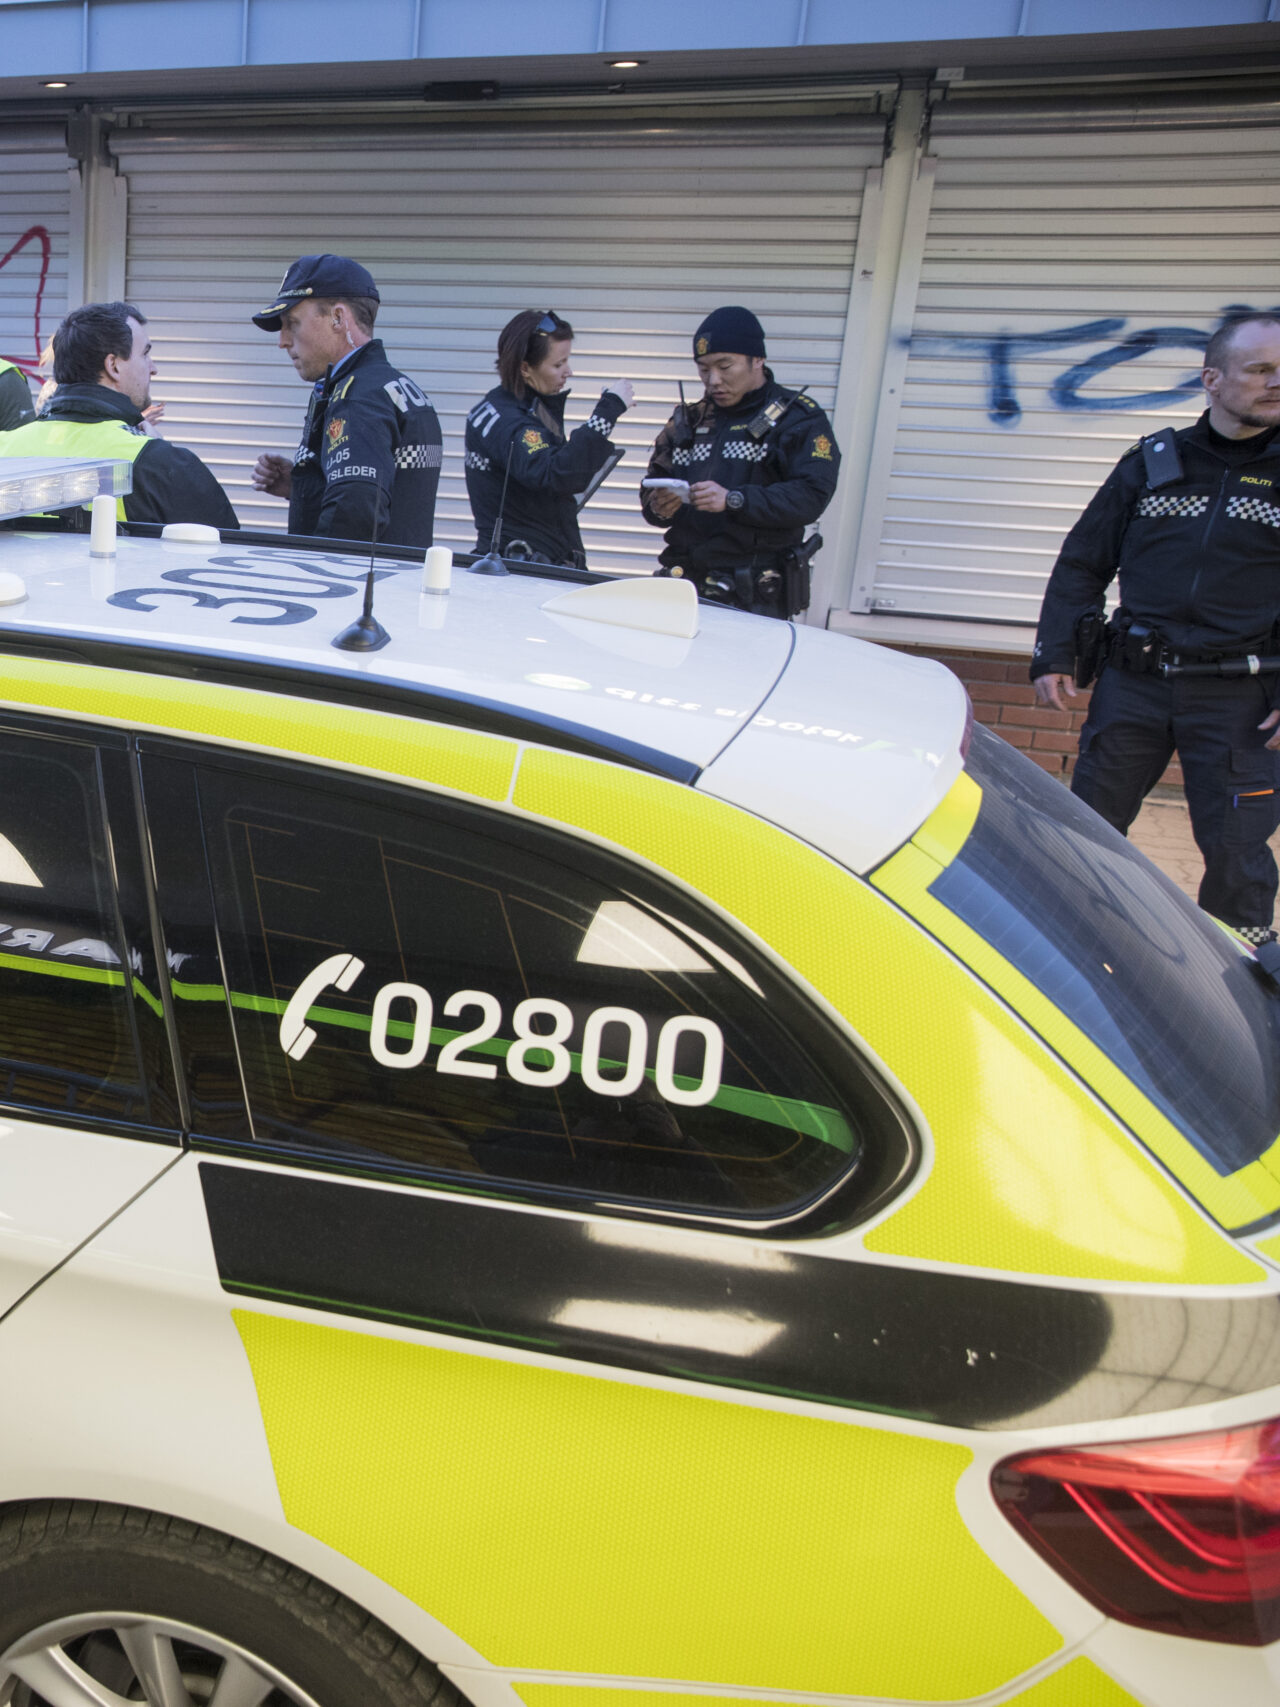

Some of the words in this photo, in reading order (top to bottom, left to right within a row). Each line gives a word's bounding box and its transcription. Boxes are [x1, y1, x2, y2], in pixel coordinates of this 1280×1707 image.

[1240, 476, 1273, 487] POLITI
[106, 549, 424, 626] 3028
[369, 980, 725, 1108] 02800
